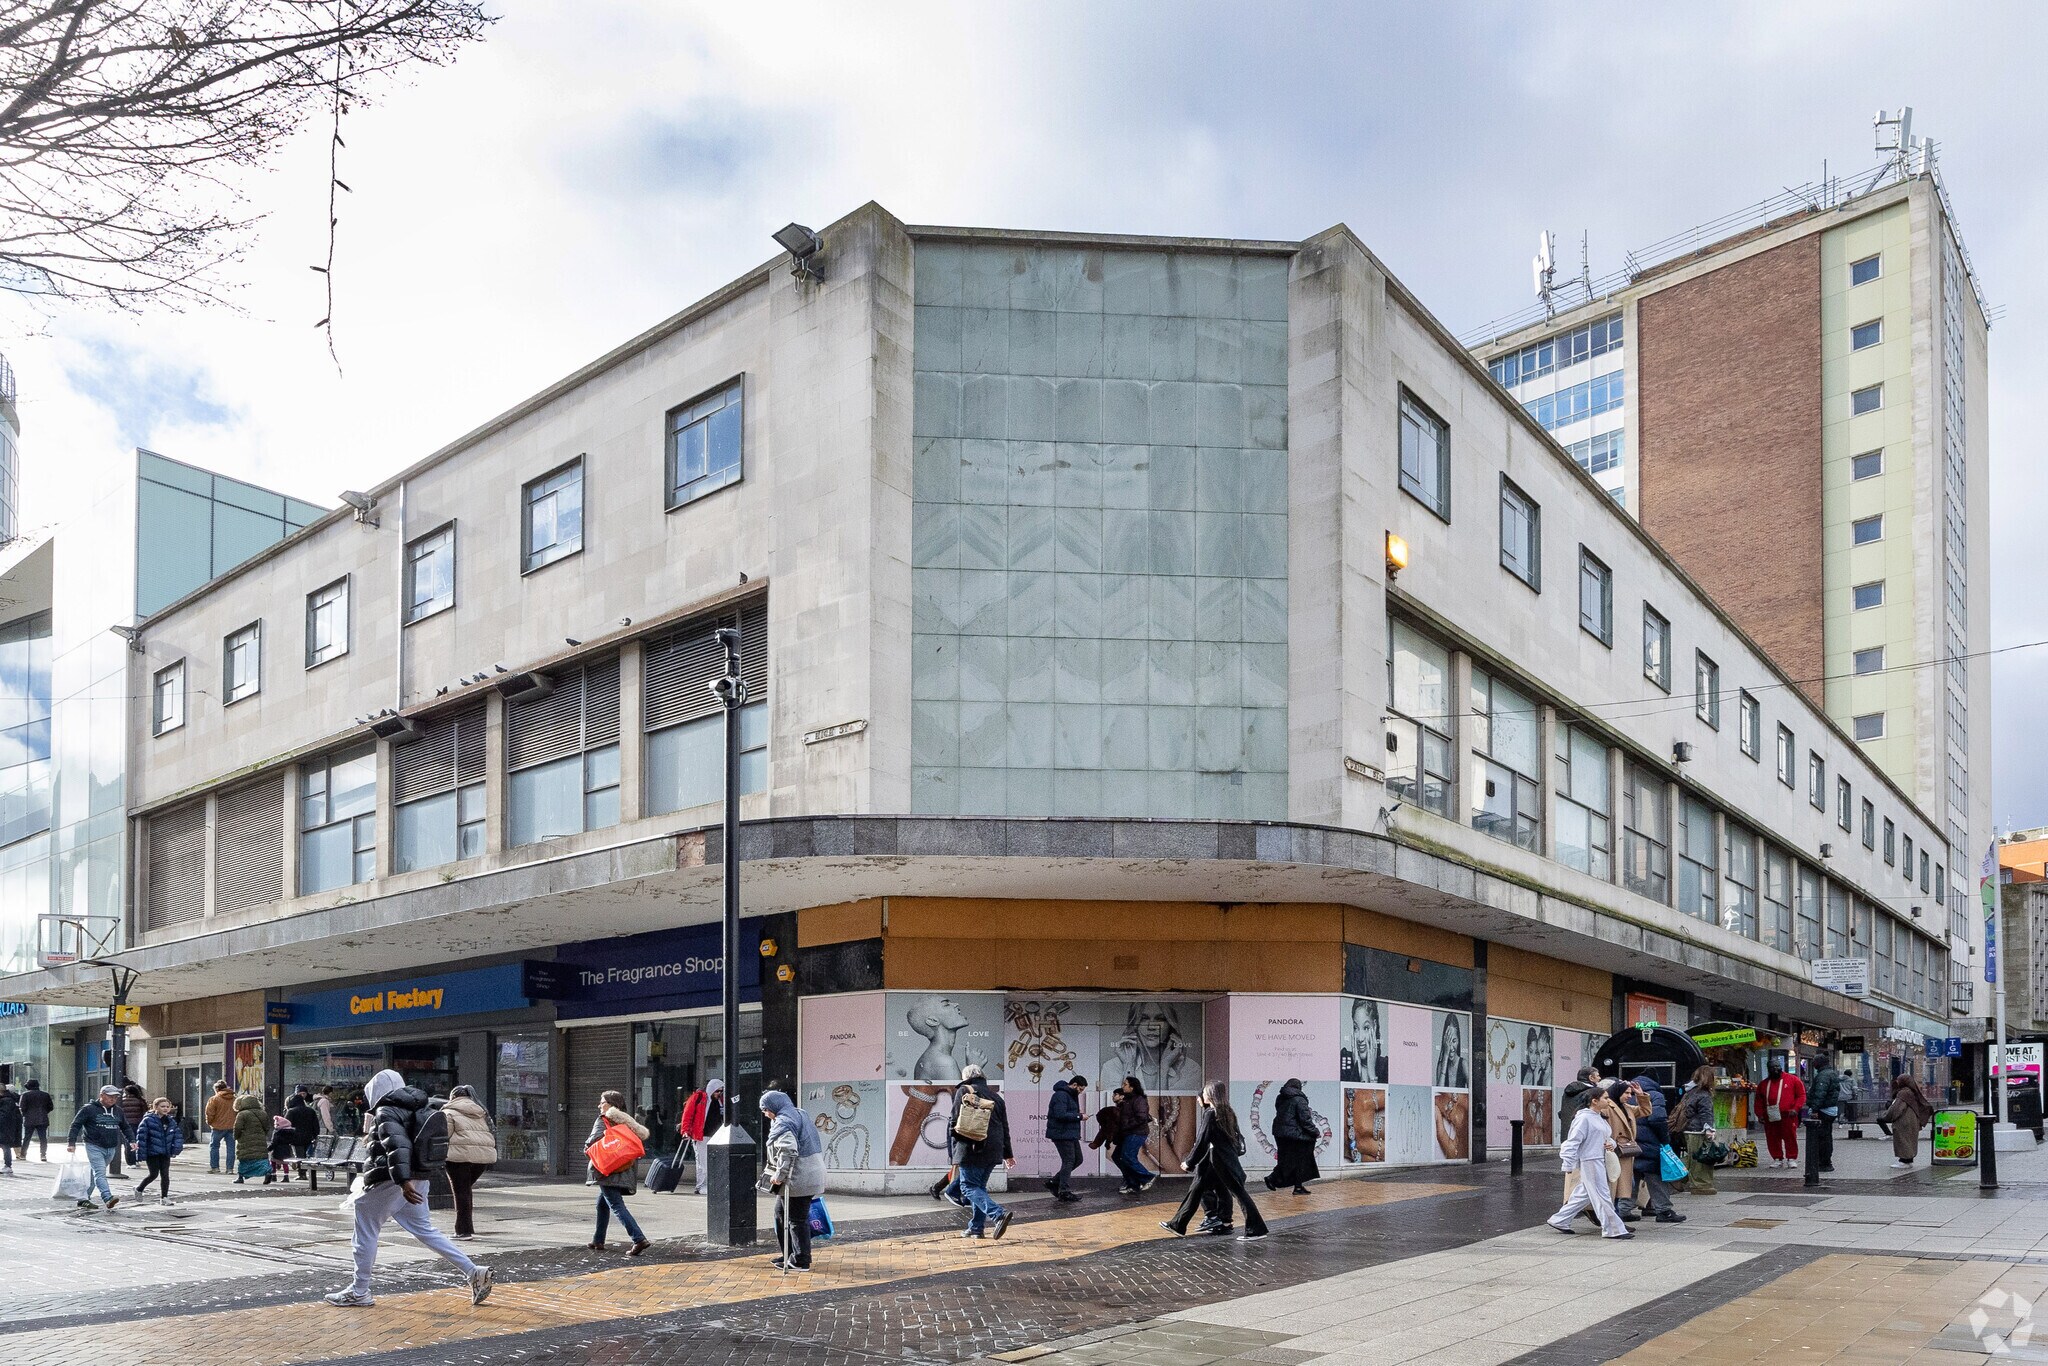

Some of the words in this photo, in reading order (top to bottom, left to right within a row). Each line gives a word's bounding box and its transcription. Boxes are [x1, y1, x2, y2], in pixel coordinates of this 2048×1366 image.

[579, 970, 604, 986] The
[608, 962, 682, 984] Fragrance
[685, 956, 724, 976] Shop
[350, 992, 383, 1015] Card
[387, 987, 444, 1010] Factory
[830, 1032, 856, 1040] PANDORA
[1710, 1035, 1728, 1043] Juices
